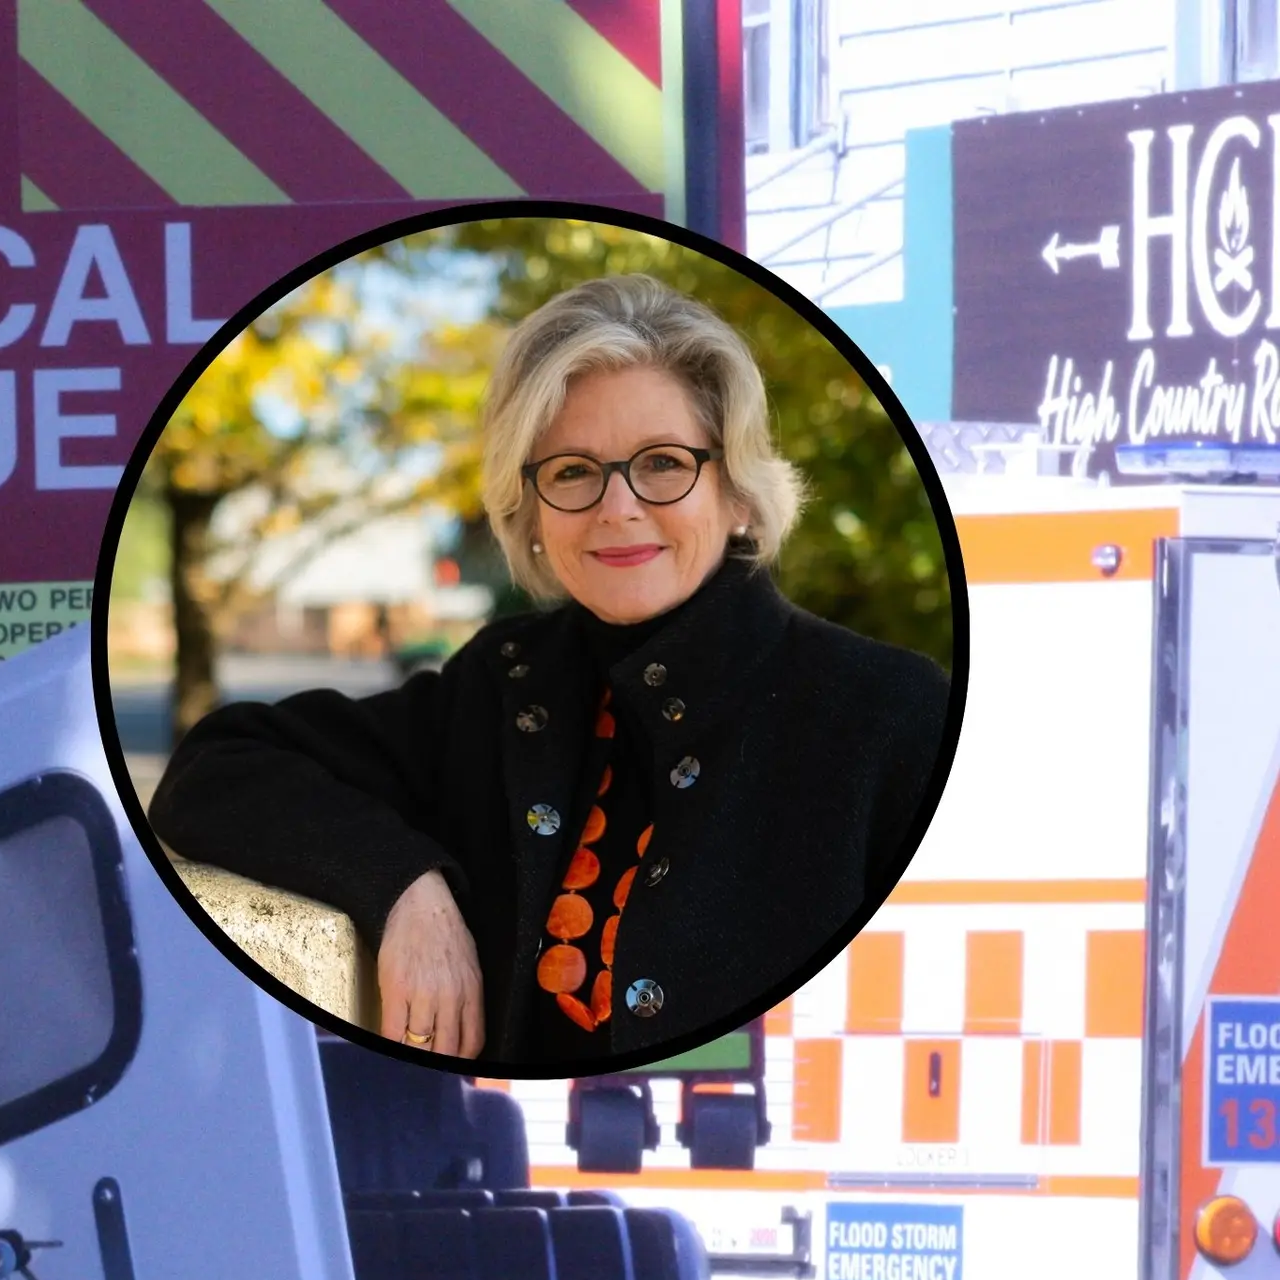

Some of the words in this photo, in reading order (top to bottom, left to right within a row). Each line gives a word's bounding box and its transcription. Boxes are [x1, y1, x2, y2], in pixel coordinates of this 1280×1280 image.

[1037, 354, 1120, 477] High
[1128, 348, 1246, 445] Country
[1219, 1098, 1280, 1150] 13
[828, 1222, 887, 1250] FLOOD
[892, 1223, 957, 1251] STORM
